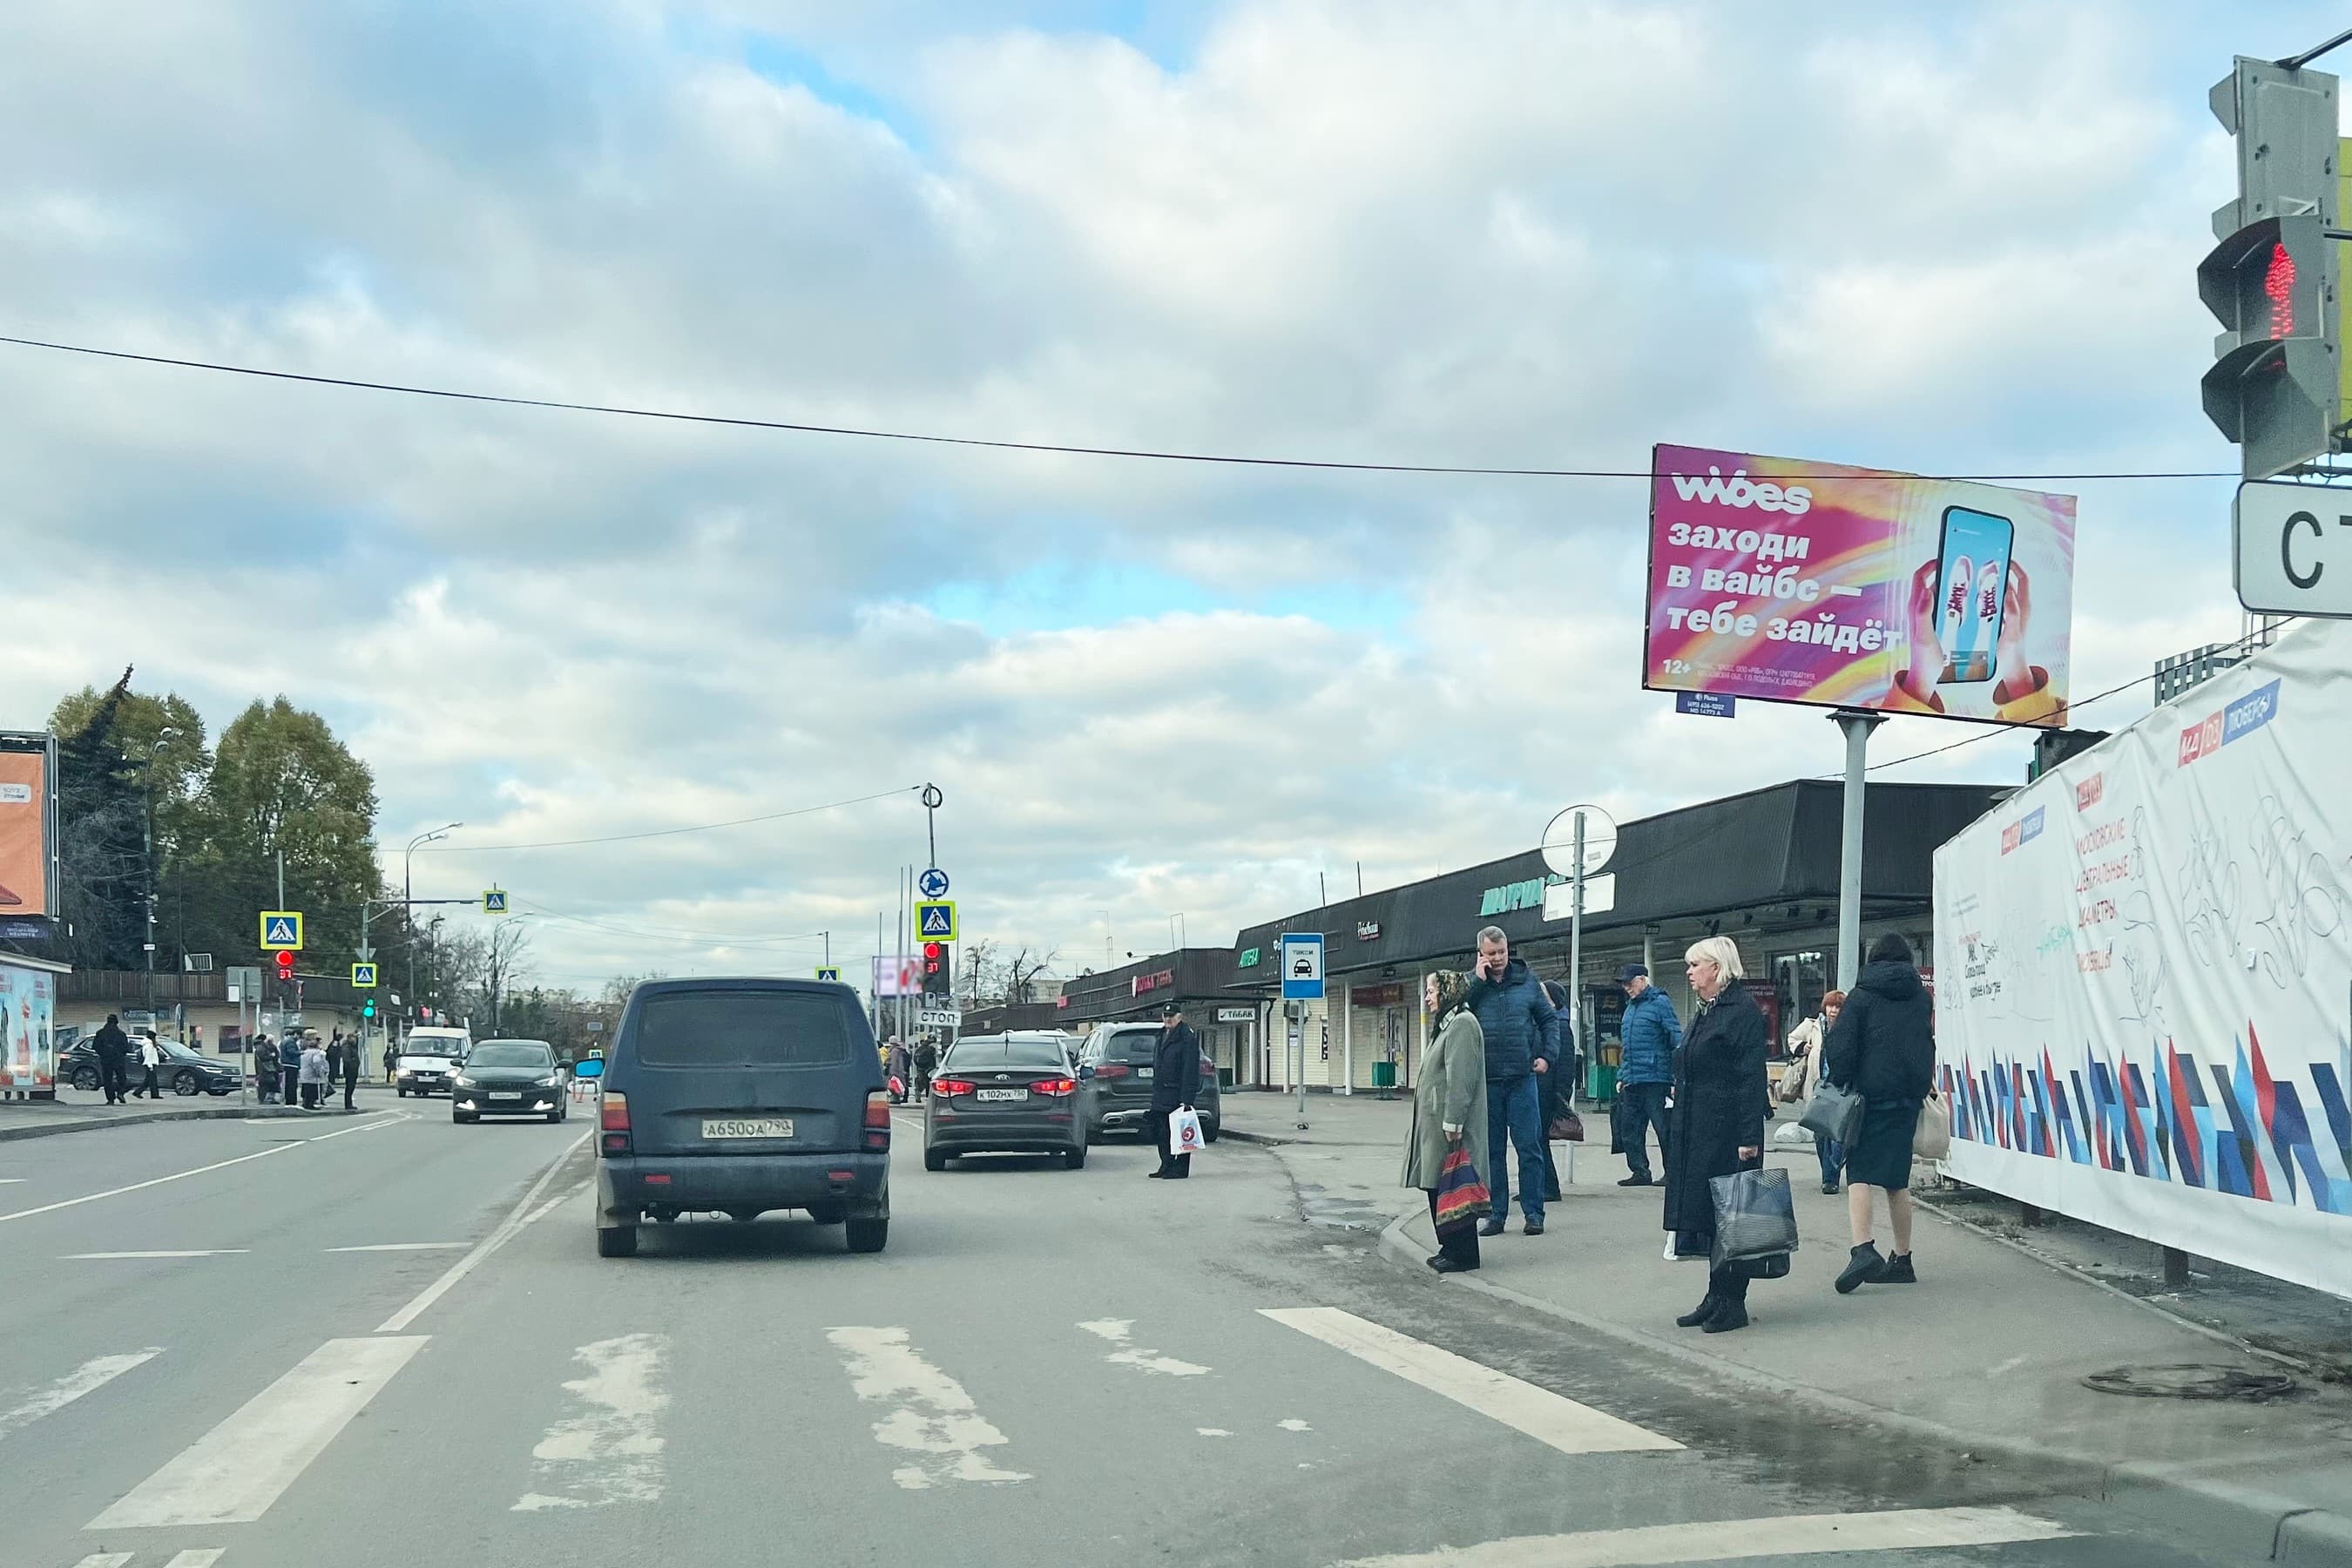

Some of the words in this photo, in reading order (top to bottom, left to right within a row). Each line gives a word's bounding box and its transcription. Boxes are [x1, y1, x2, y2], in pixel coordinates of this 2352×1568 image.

[1668, 523, 1810, 562] заходи
[1666, 565, 1692, 588] в
[1700, 564, 1820, 602] вайбс
[1667, 600, 1758, 637] тебе
[1766, 612, 1903, 654] зайдёт
[1663, 659, 1692, 674] 12+
[279, 969, 292, 980] 37
[927, 963, 939, 973] 37
[707, 1121, 765, 1136] А650ОА
